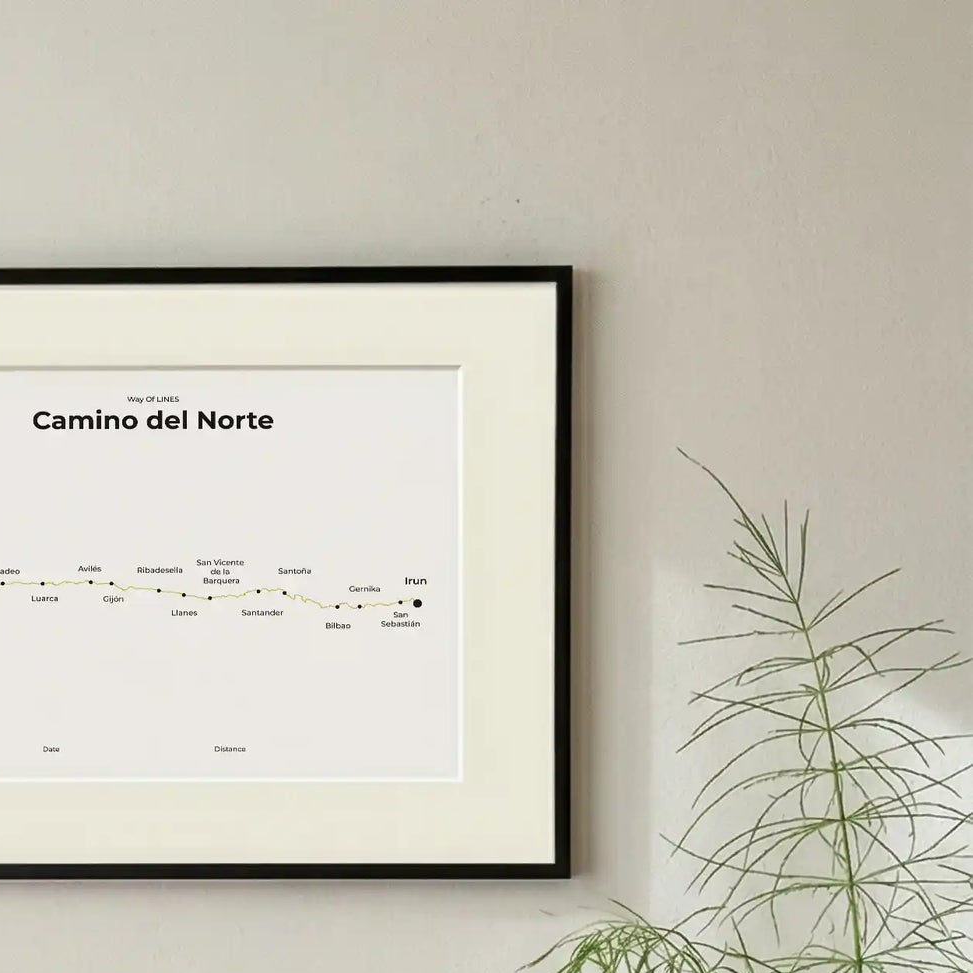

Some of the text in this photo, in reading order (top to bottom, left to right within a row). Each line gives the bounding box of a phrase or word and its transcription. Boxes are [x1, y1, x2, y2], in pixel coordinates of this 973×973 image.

[127, 395, 180, 404] Way Of LINES
[32, 408, 274, 430] Camino del Norte
[196, 558, 245, 567] San Vicente
[77, 564, 102, 573] Avilés
[136, 566, 183, 574] Ribadesella
[210, 567, 231, 576] de la
[277, 566, 312, 575] Santoña
[203, 577, 240, 586] Barquera
[404, 576, 428, 586] Irun
[348, 585, 381, 593] Gernika
[102, 594, 125, 604] Gijón
[171, 609, 198, 617] Llanes
[241, 609, 284, 617] Santander
[393, 611, 409, 619] San
[325, 621, 352, 630] Bilbao
[380, 619, 421, 628] Sebastián
[42, 745, 60, 753] Date
[214, 745, 246, 753] Distance
